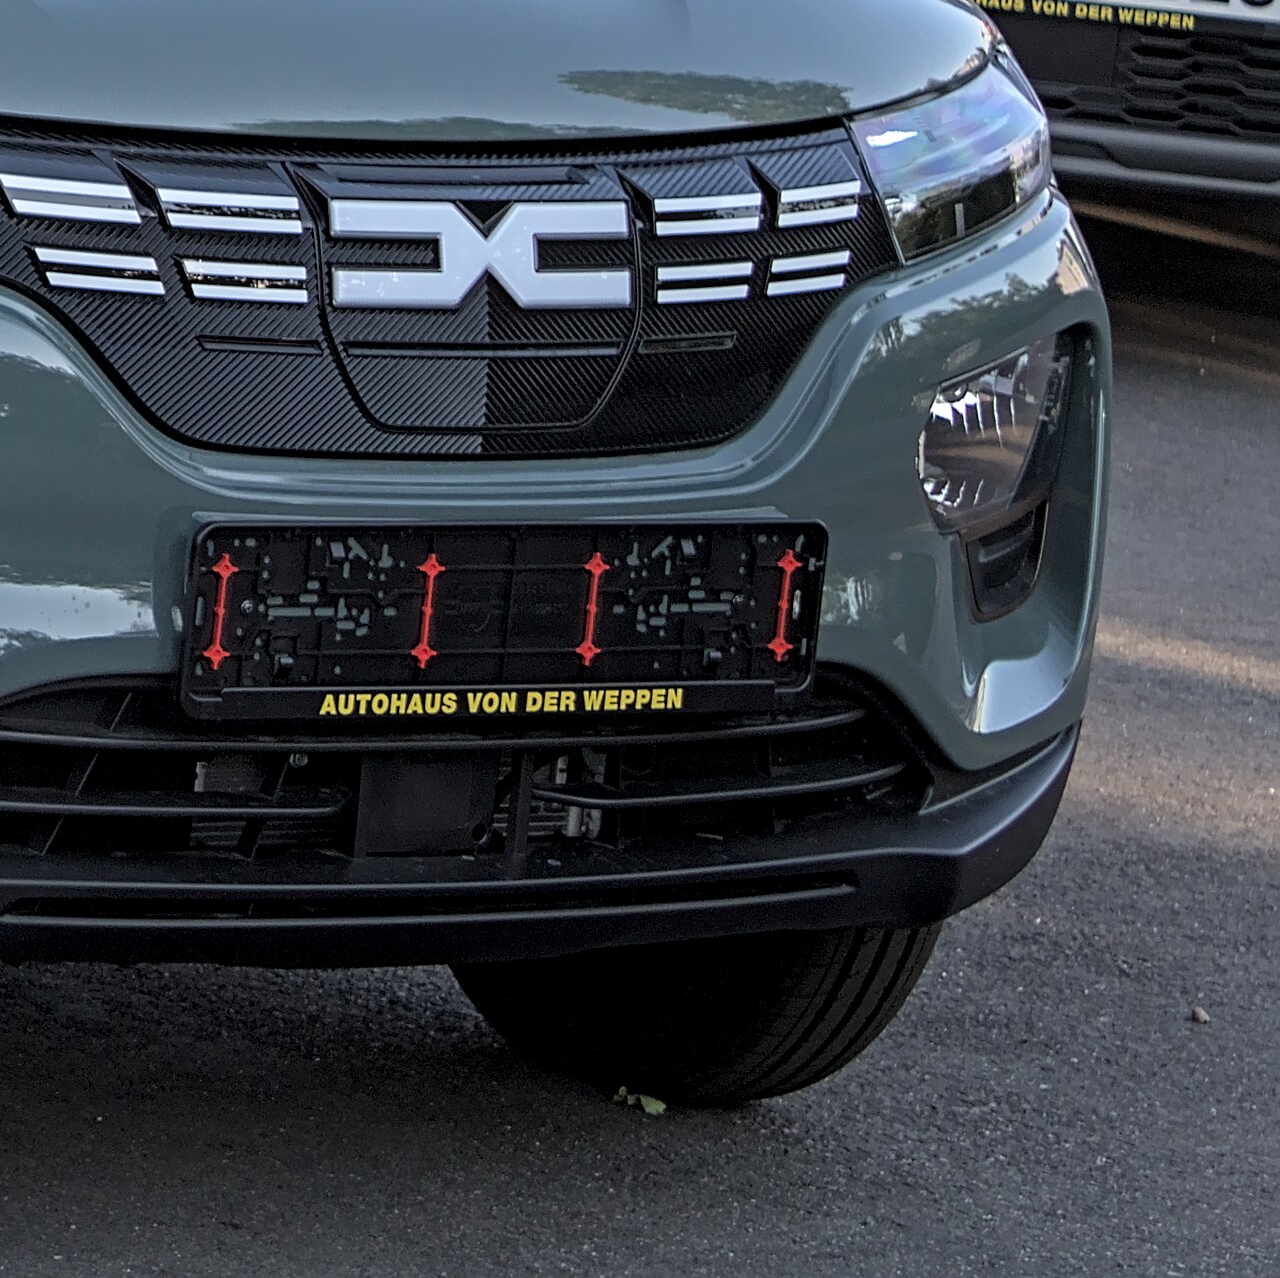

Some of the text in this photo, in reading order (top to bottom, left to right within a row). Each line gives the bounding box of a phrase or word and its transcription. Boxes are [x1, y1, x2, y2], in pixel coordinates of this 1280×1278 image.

[1075, 3, 1113, 23] DER
[1118, 7, 1195, 31] WEPPEN
[319, 688, 683, 715] AUTOHAUS VON DER WEPPEN
